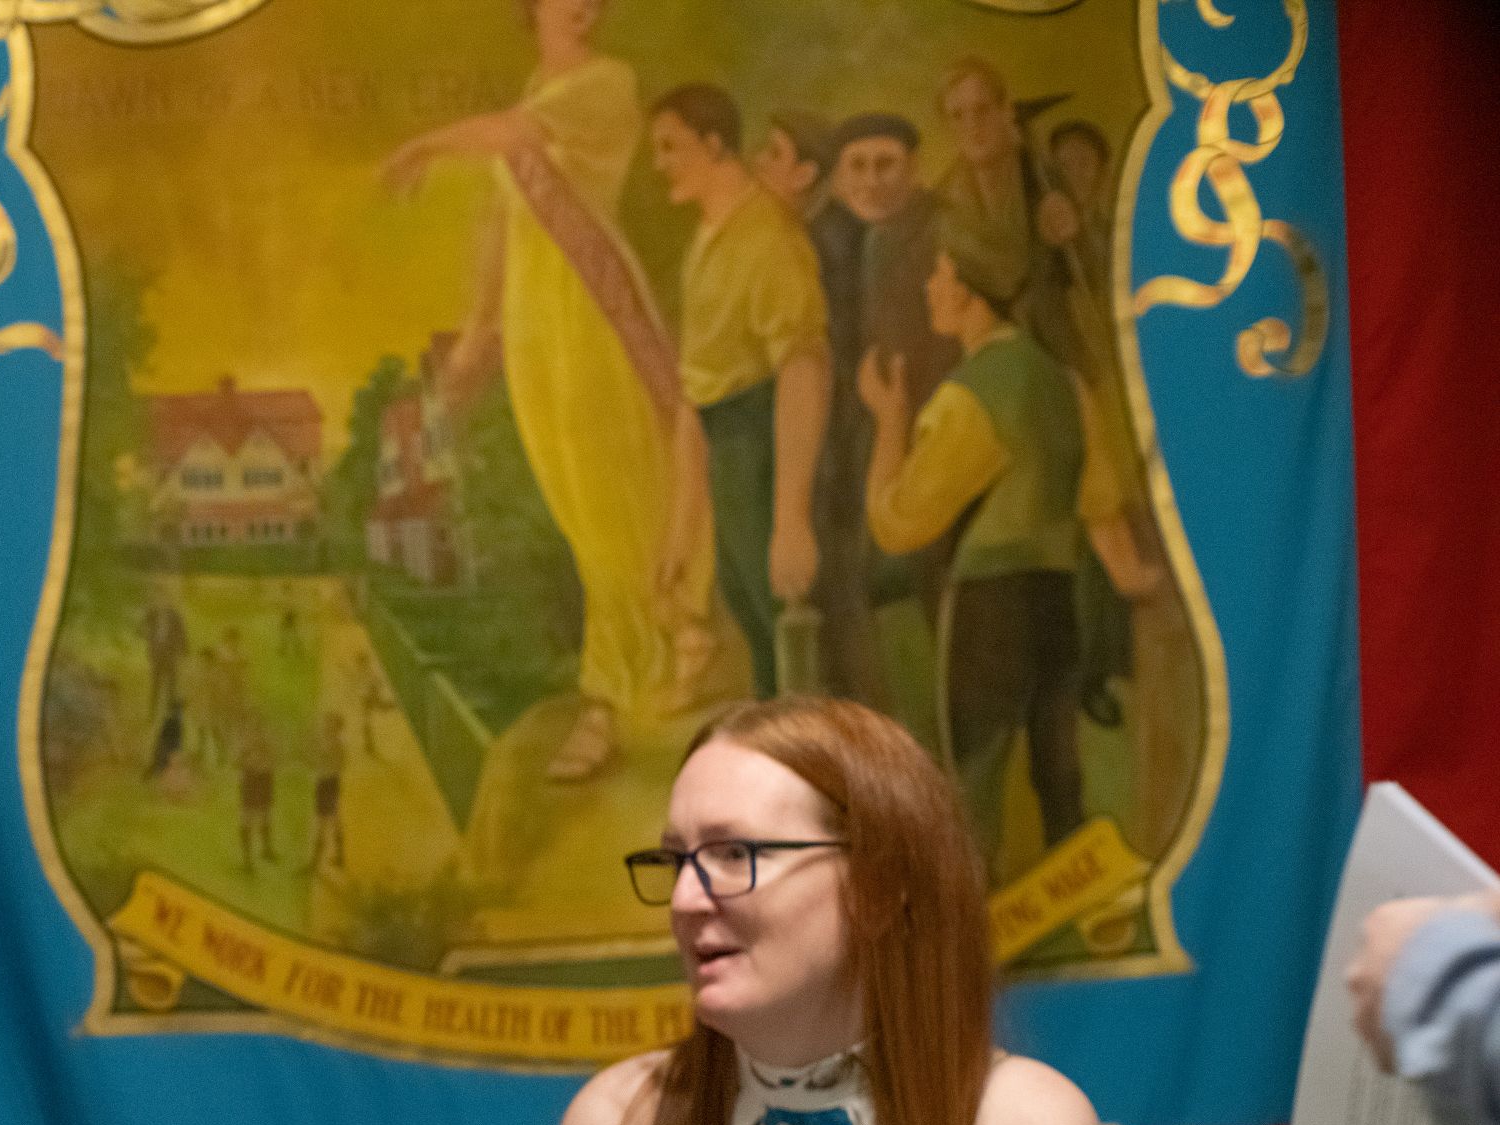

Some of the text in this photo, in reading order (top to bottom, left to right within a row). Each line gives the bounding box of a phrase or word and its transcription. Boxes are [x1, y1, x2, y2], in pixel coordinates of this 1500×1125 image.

[283, 959, 346, 1010] FOR
[355, 981, 405, 1026] THE
[424, 998, 532, 1043] HEALTH
[540, 1006, 574, 1043] OF
[591, 1006, 645, 1045] THE
